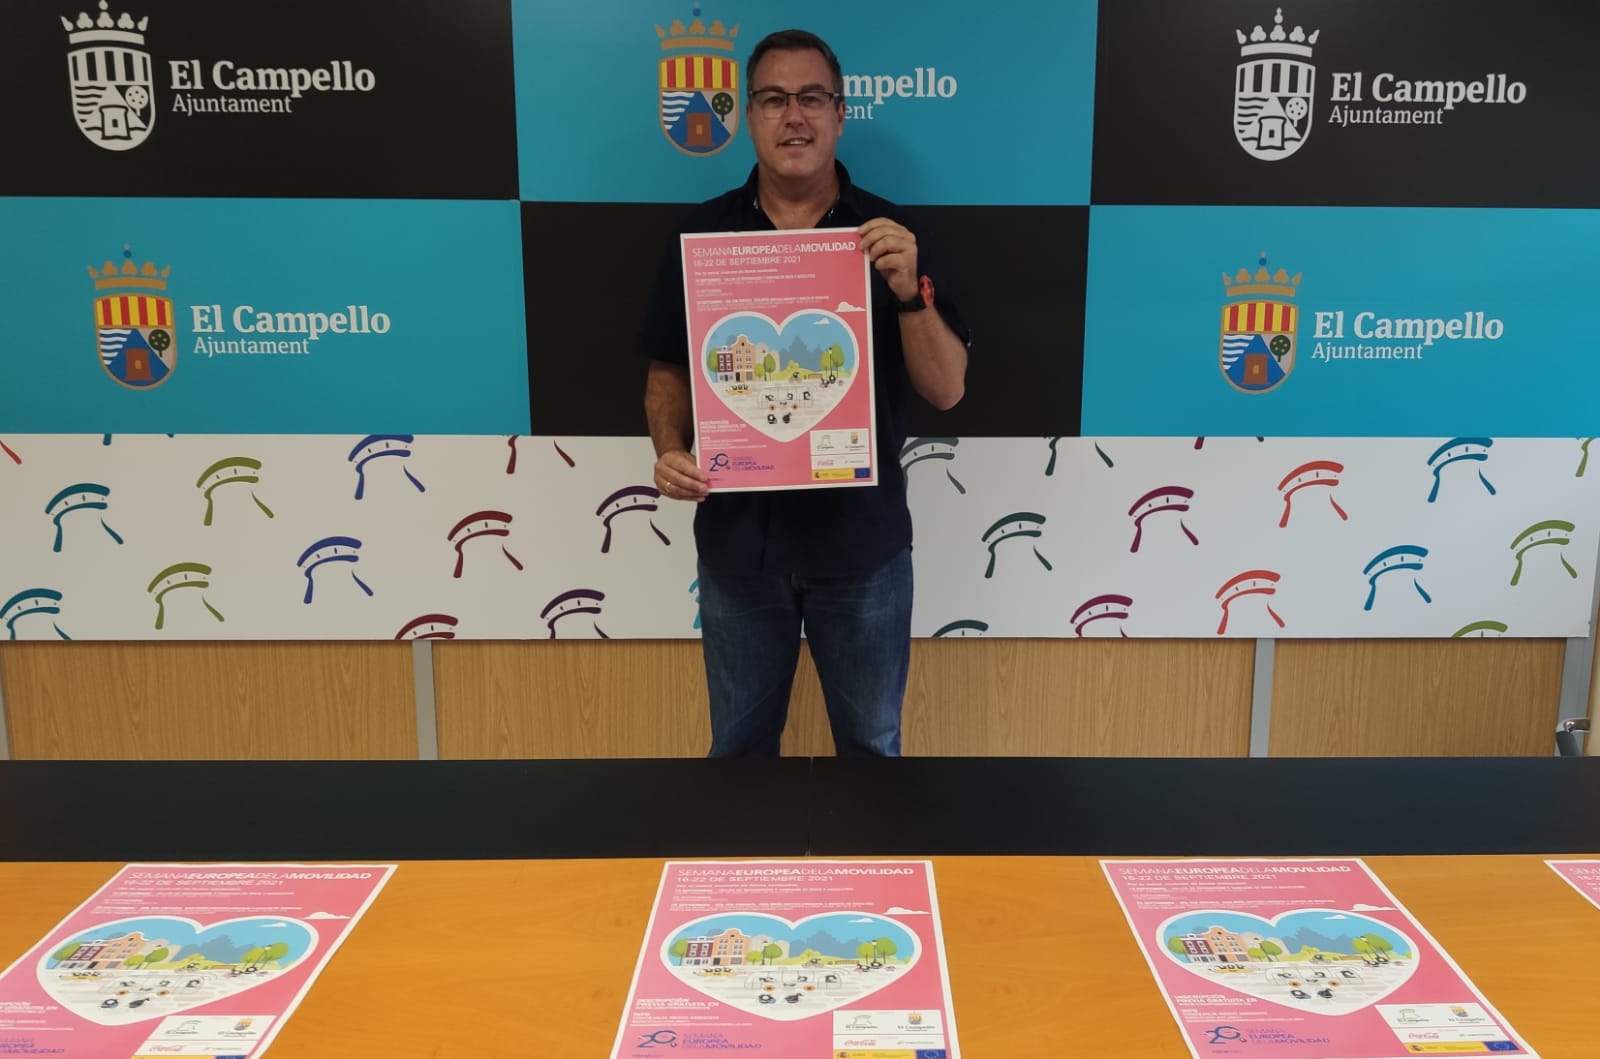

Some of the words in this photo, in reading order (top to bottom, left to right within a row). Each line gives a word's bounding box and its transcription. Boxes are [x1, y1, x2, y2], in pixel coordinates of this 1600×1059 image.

[168, 59, 204, 90] El
[211, 60, 376, 97] Campello
[842, 66, 958, 105] mpello
[1330, 71, 1363, 101] El
[1371, 73, 1527, 110] Campello
[171, 93, 293, 116] Ajuntament
[1328, 105, 1444, 127] Ajuntament
[190, 304, 225, 333] El
[232, 305, 391, 340] Campello
[1313, 310, 1345, 339] El
[1353, 311, 1504, 346] Campello
[193, 336, 311, 357] Ajuntament
[1311, 342, 1424, 363] Ajuntament
